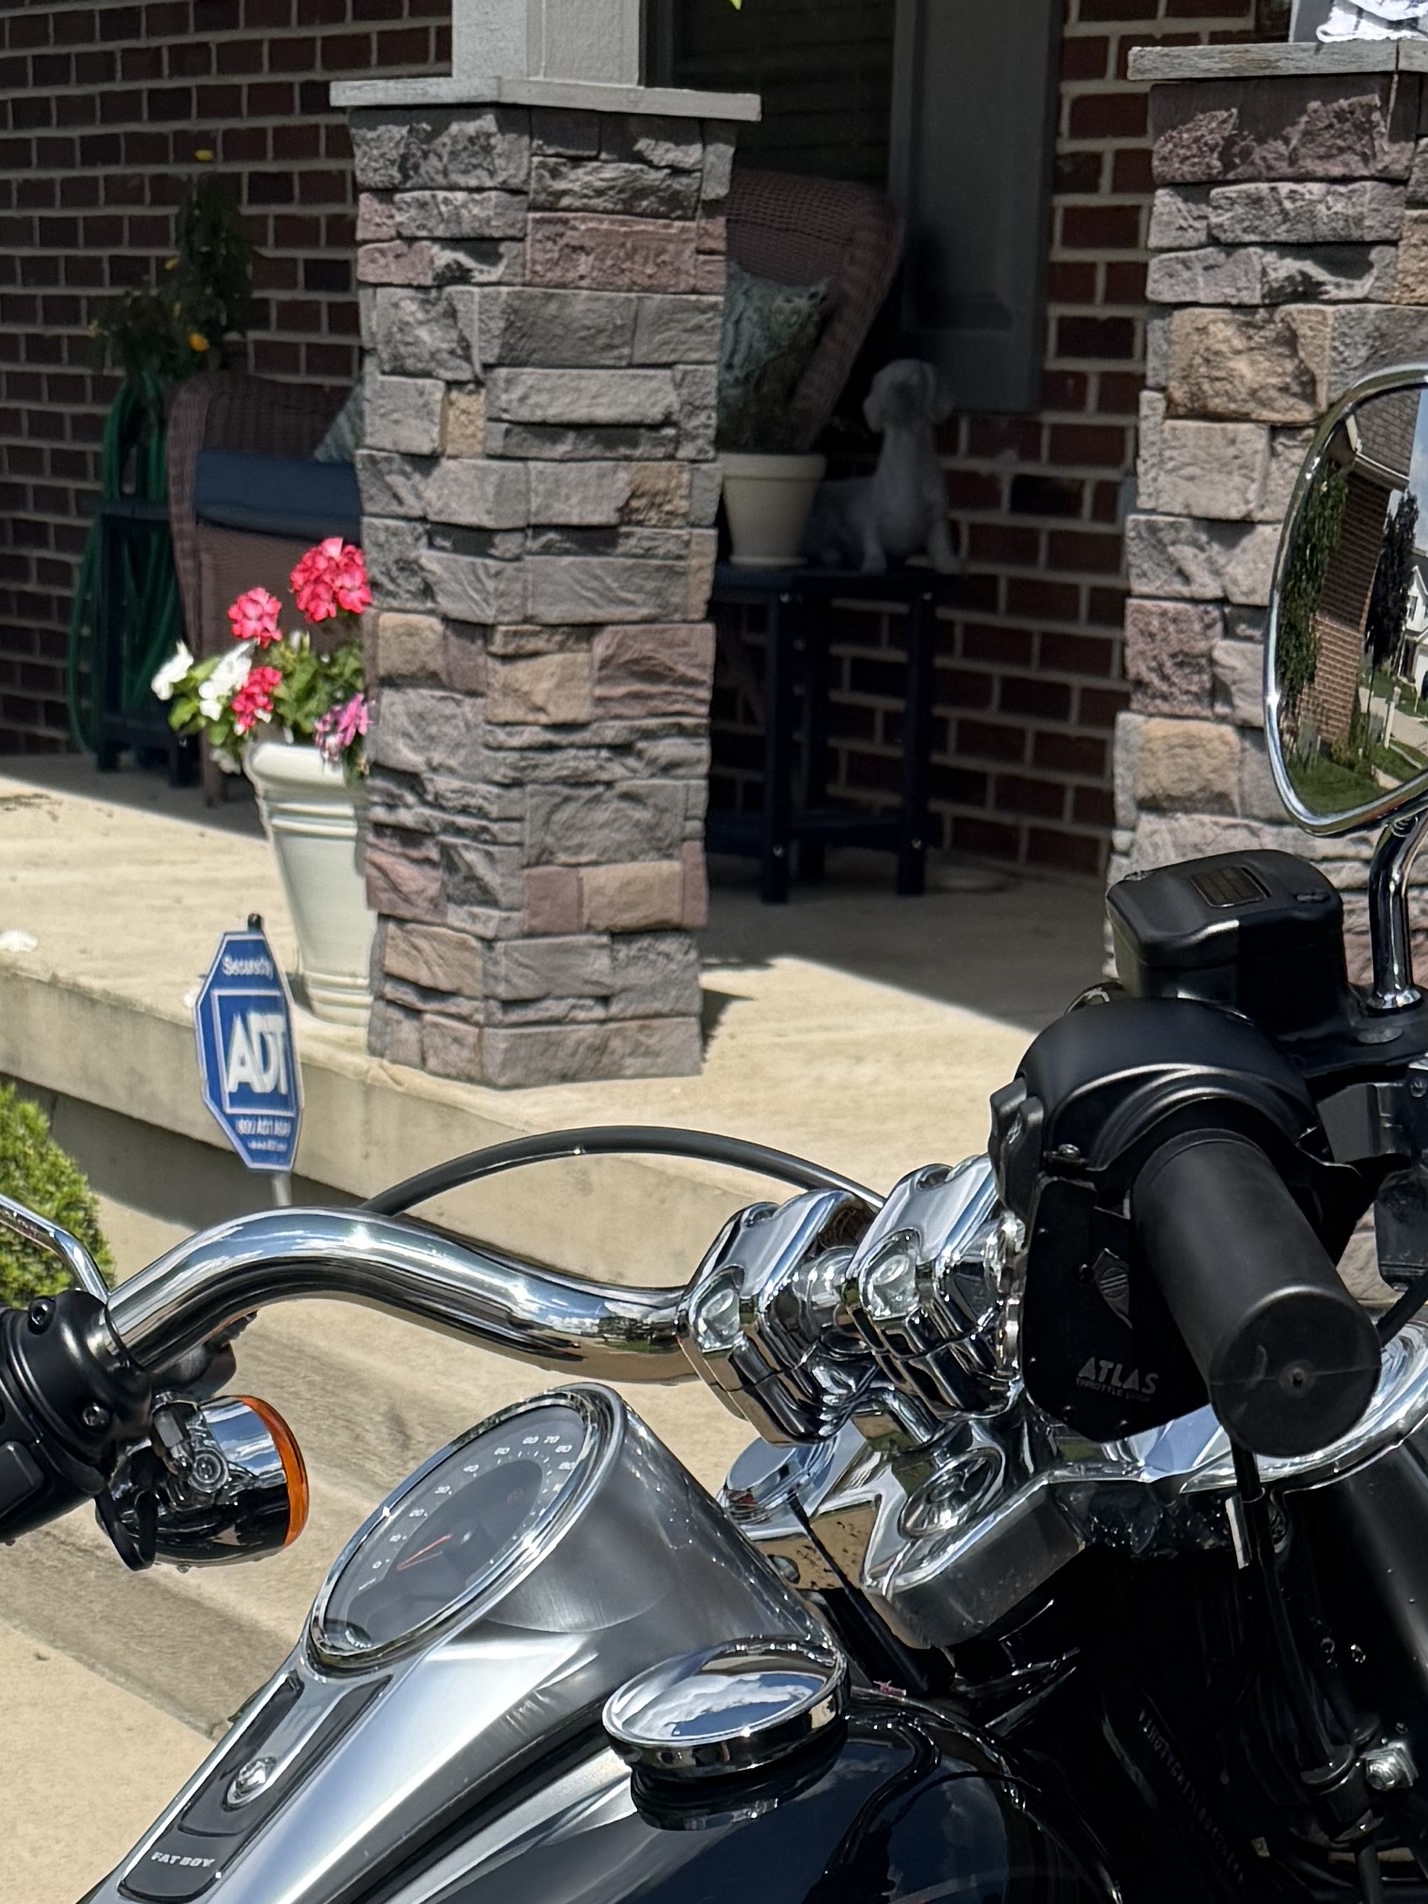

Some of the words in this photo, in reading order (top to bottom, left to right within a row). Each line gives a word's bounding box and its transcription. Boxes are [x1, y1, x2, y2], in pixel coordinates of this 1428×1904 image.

[227, 1010, 289, 1095] ADT
[1077, 1356, 1160, 1394] ATLAS
[150, 1851, 181, 1865] FAT
[179, 1856, 216, 1868] BOY
